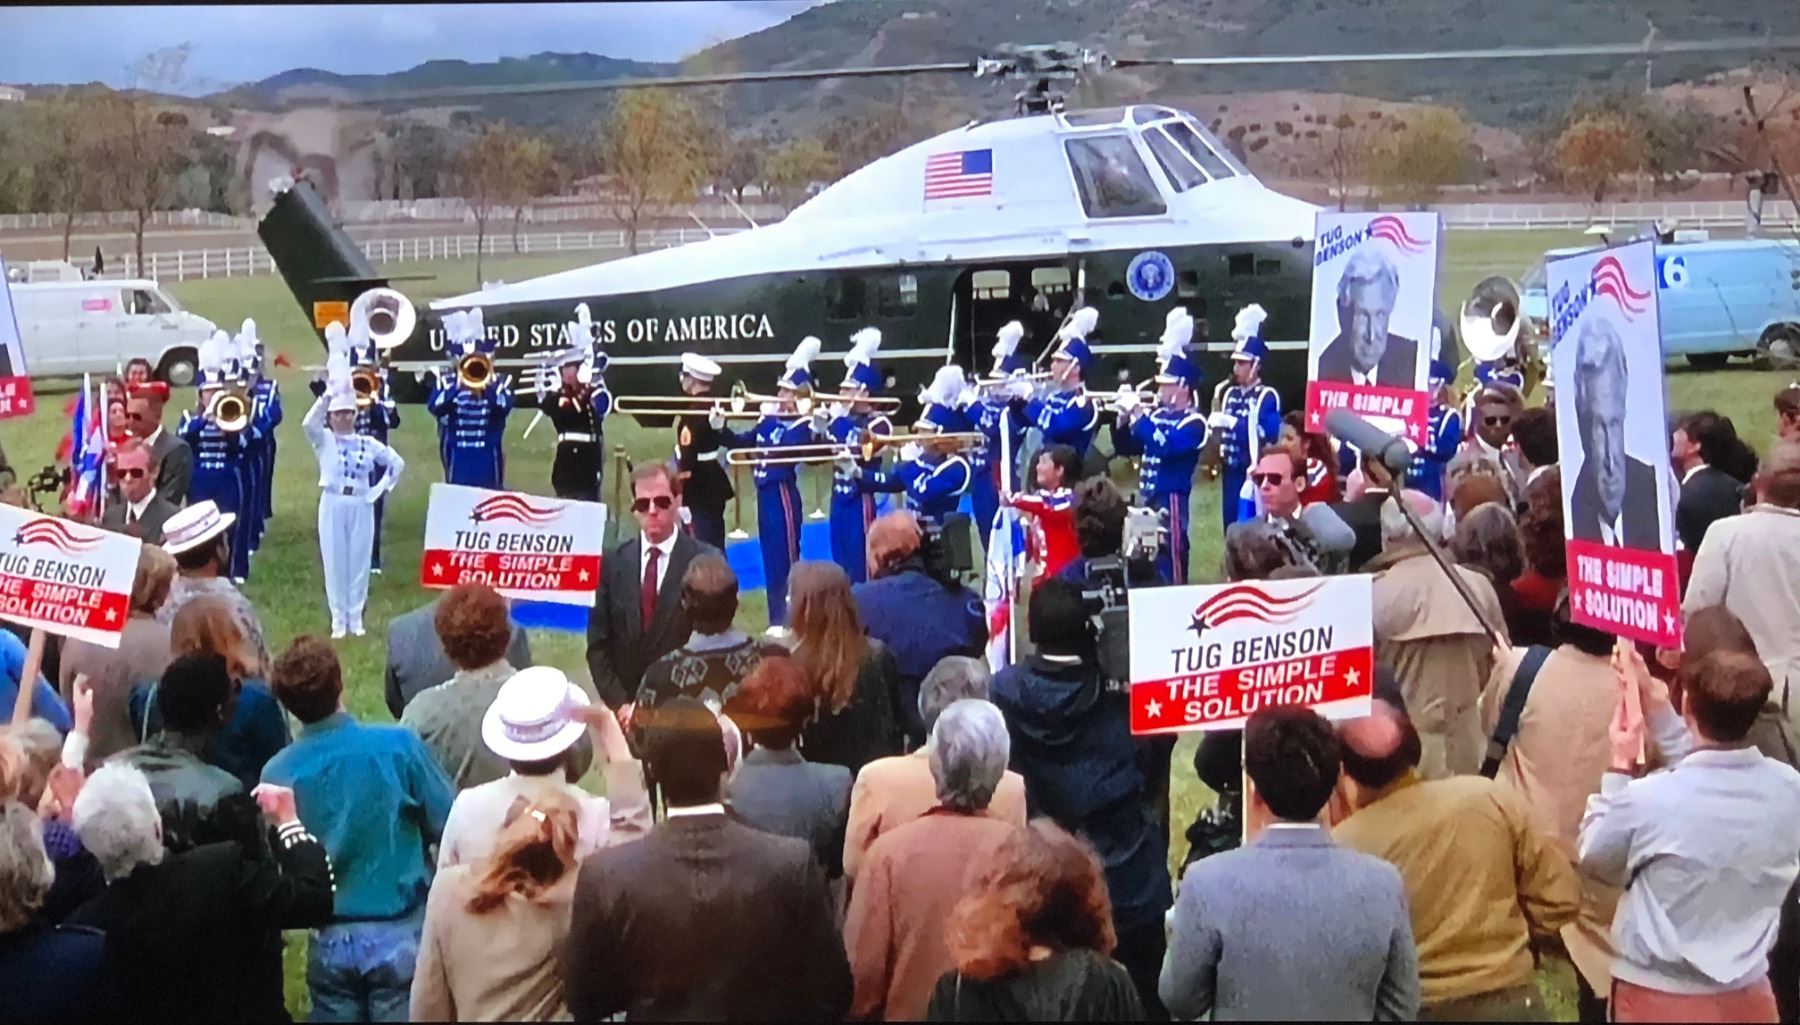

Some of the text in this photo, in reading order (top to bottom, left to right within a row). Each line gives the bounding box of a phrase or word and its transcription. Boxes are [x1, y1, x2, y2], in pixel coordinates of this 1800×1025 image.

[1315, 230, 1362, 266] BENSON
[1321, 225, 1342, 247] TUG
[1663, 255, 1689, 288] 6
[627, 318, 659, 342] OF
[664, 313, 775, 341] AMERICA
[1320, 390, 1414, 416] THE SIMPLE
[455, 530, 573, 553] TUG BENSON
[32, 559, 106, 587] BENSON
[449, 553, 574, 572] THE SIMPLE
[457, 570, 561, 587] SOLUTION
[1577, 554, 1663, 598] THE SIMPLE
[0, 575, 104, 609] HE SIMPLE
[1585, 588, 1658, 632] SOLUTION
[1171, 625, 1333, 673] TUG BENSON
[1166, 655, 1337, 701] THE SIMPLE
[1184, 681, 1324, 722] SOLUTION
